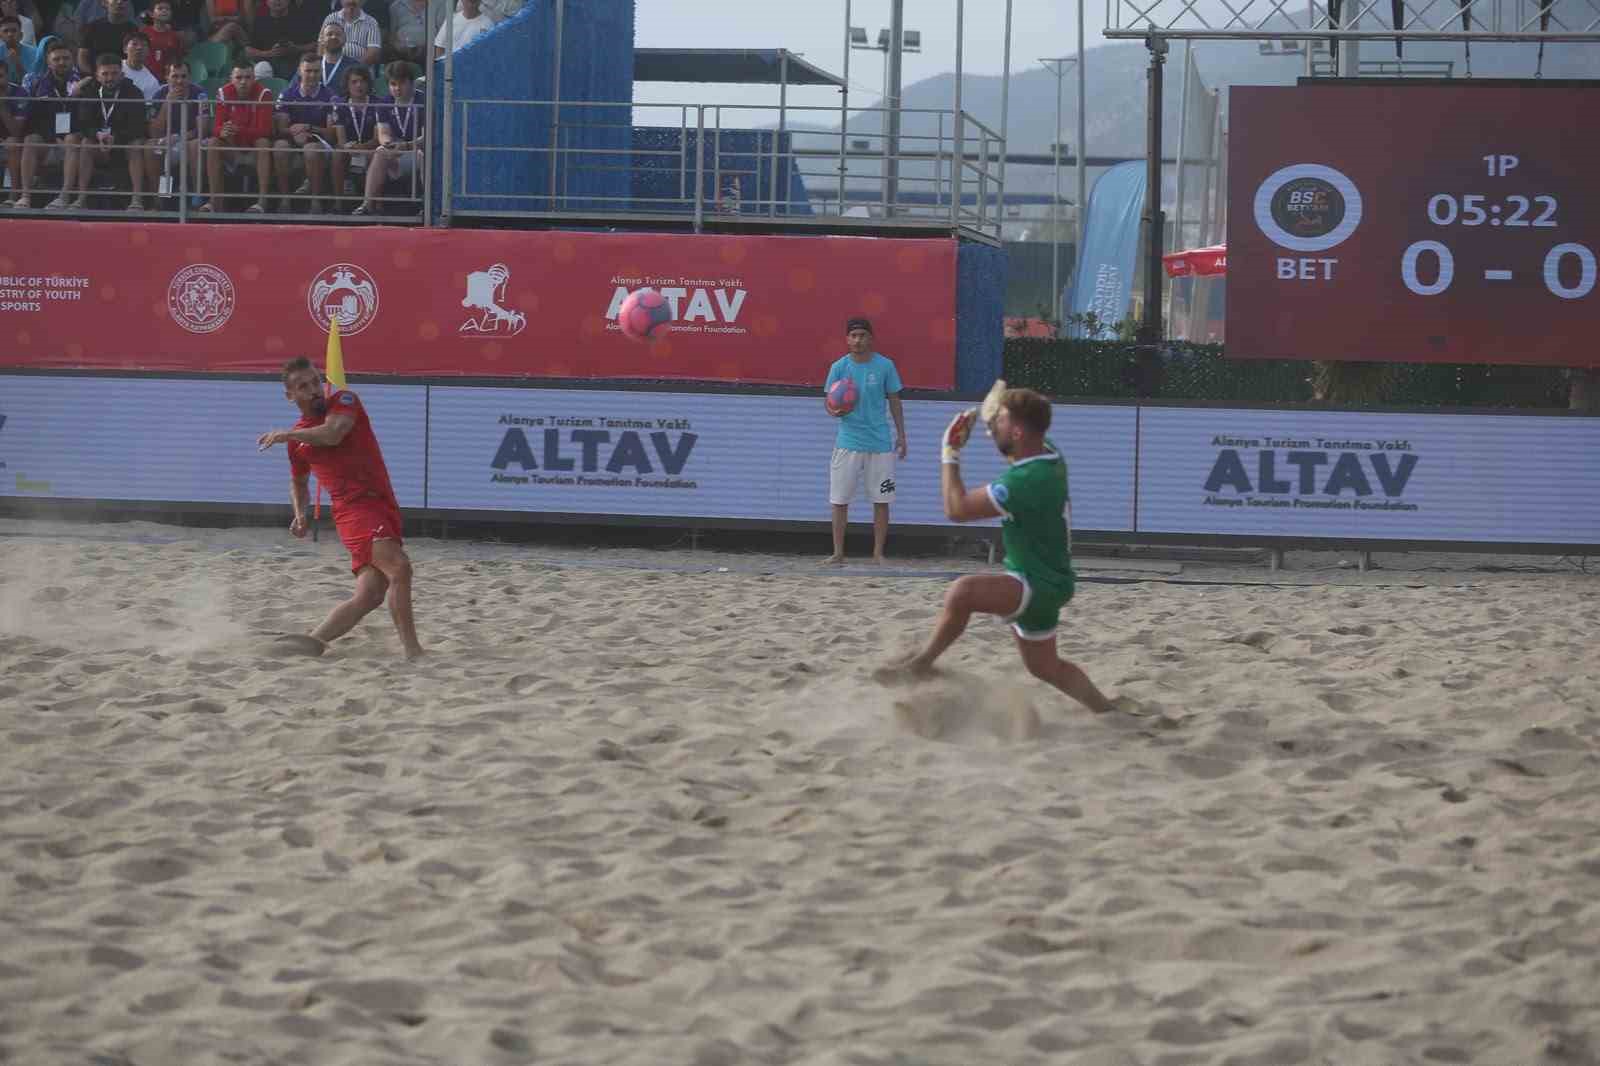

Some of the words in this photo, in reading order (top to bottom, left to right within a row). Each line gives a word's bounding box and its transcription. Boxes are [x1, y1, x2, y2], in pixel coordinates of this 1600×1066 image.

[1483, 154, 1519, 177] 1P
[1427, 193, 1559, 228] 05:22
[1276, 258, 1339, 281] BET
[1401, 240, 1455, 296] 0
[1543, 242, 1598, 300] 0
[0, 276, 26, 287] BLIC
[28, 277, 43, 287] OF
[45, 275, 89, 288] TÜRKİYE
[610, 276, 642, 286] Alanya
[645, 276, 676, 286] Turizm
[27, 290, 42, 299] OF
[44, 290, 81, 300] YOUTH
[1, 302, 41, 312] SPORTS
[605, 286, 747, 323] ATAV
[704, 325, 746, 335] Foundation
[498, 414, 544, 427] Alanya
[549, 415, 593, 427] Turizm
[1210, 434, 1259, 449] Alanya
[1263, 436, 1311, 449] Turizm
[490, 427, 698, 475] ALTAV
[490, 473, 529, 485] Alanya
[531, 474, 576, 486] Tourism
[577, 475, 632, 488] Promotion
[635, 477, 697, 489] Foundation
[1203, 449, 1420, 497] ALTAV
[1203, 495, 1243, 508] Alanya
[1245, 496, 1290, 508] Tourism
[1293, 498, 1352, 510] Promotion
[1354, 499, 1419, 511] Foundation
